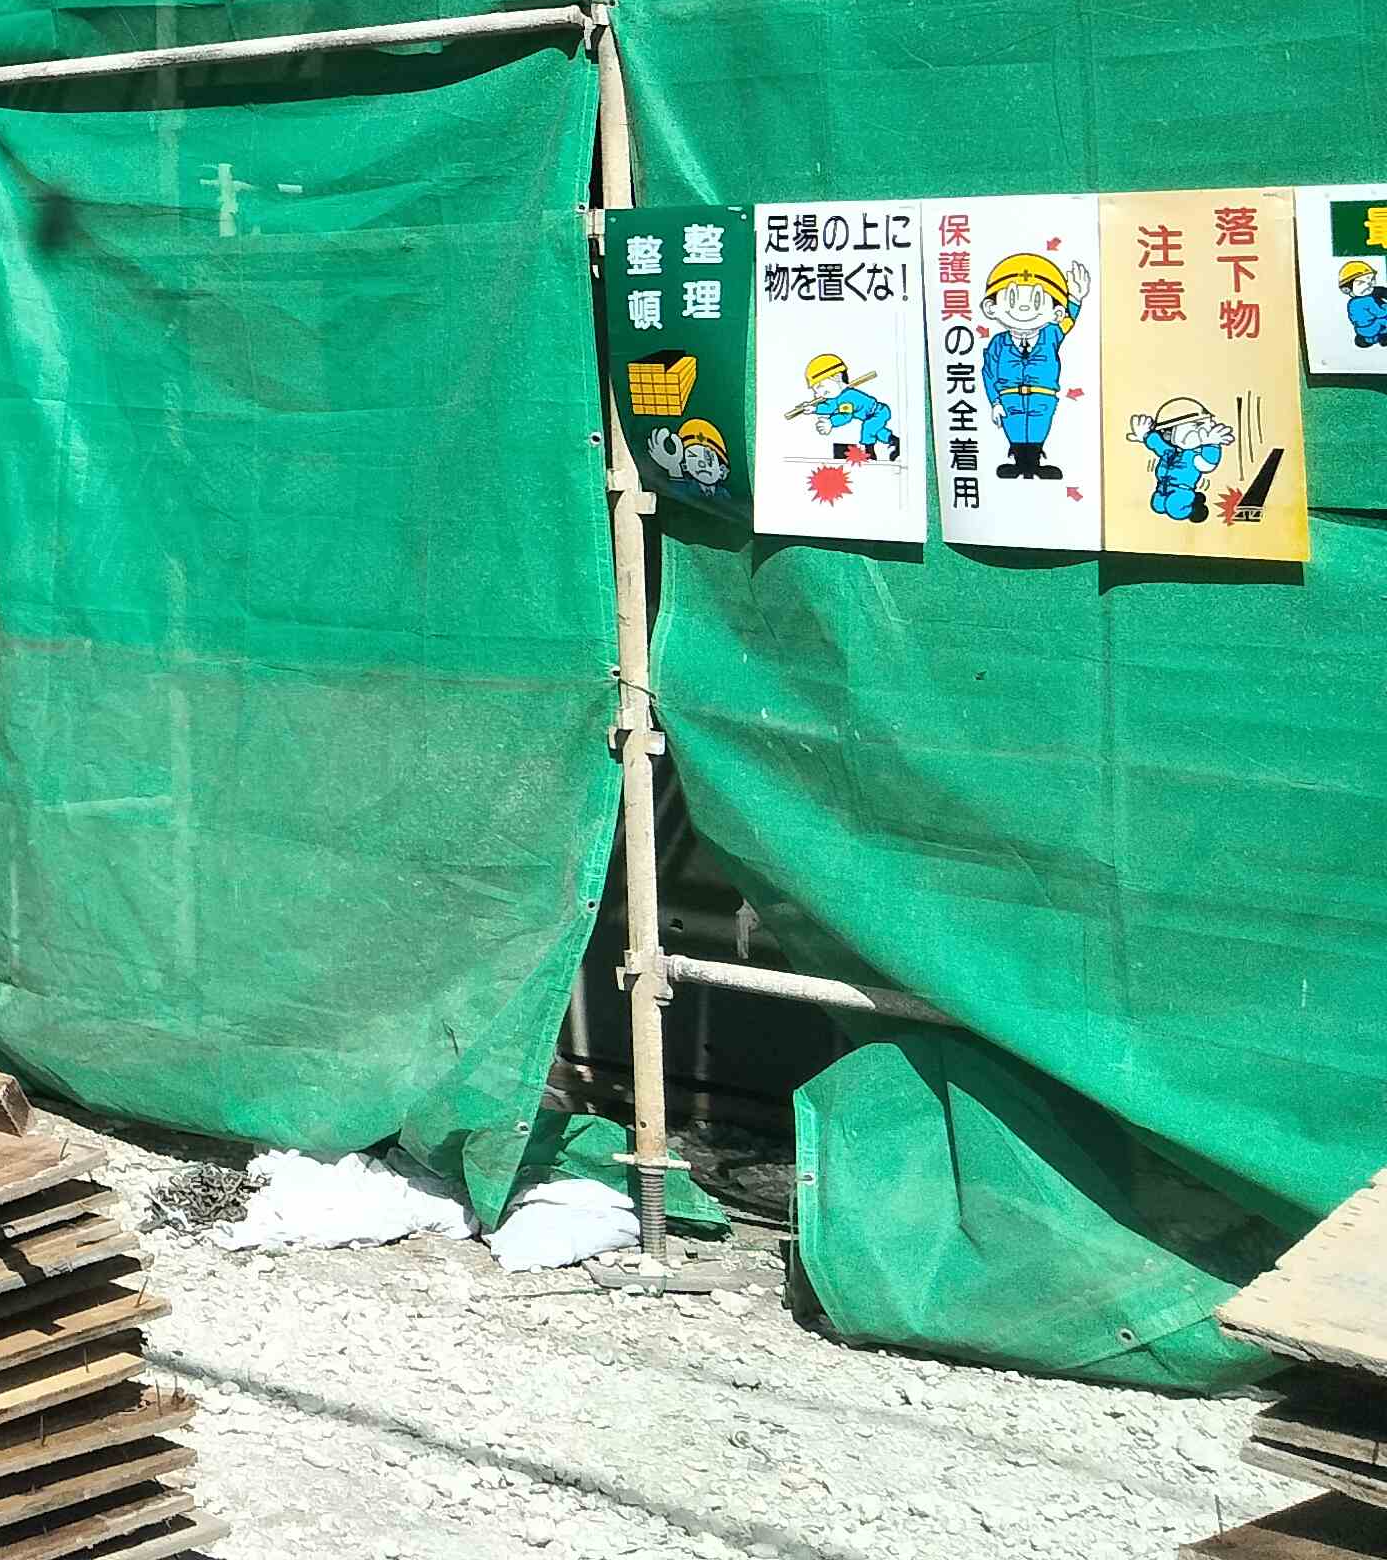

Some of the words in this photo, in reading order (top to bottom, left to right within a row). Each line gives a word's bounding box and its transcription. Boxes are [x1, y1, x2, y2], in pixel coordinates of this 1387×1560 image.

[681, 223, 726, 319] 整理
[764, 212, 913, 254] 足場の上に
[1137, 224, 1188, 323] 注意
[1214, 206, 1261, 339] 落下物
[626, 235, 664, 330] 整頓
[764, 262, 910, 303] 物を置くな!
[938, 214, 980, 509] 保護具の完全着用
